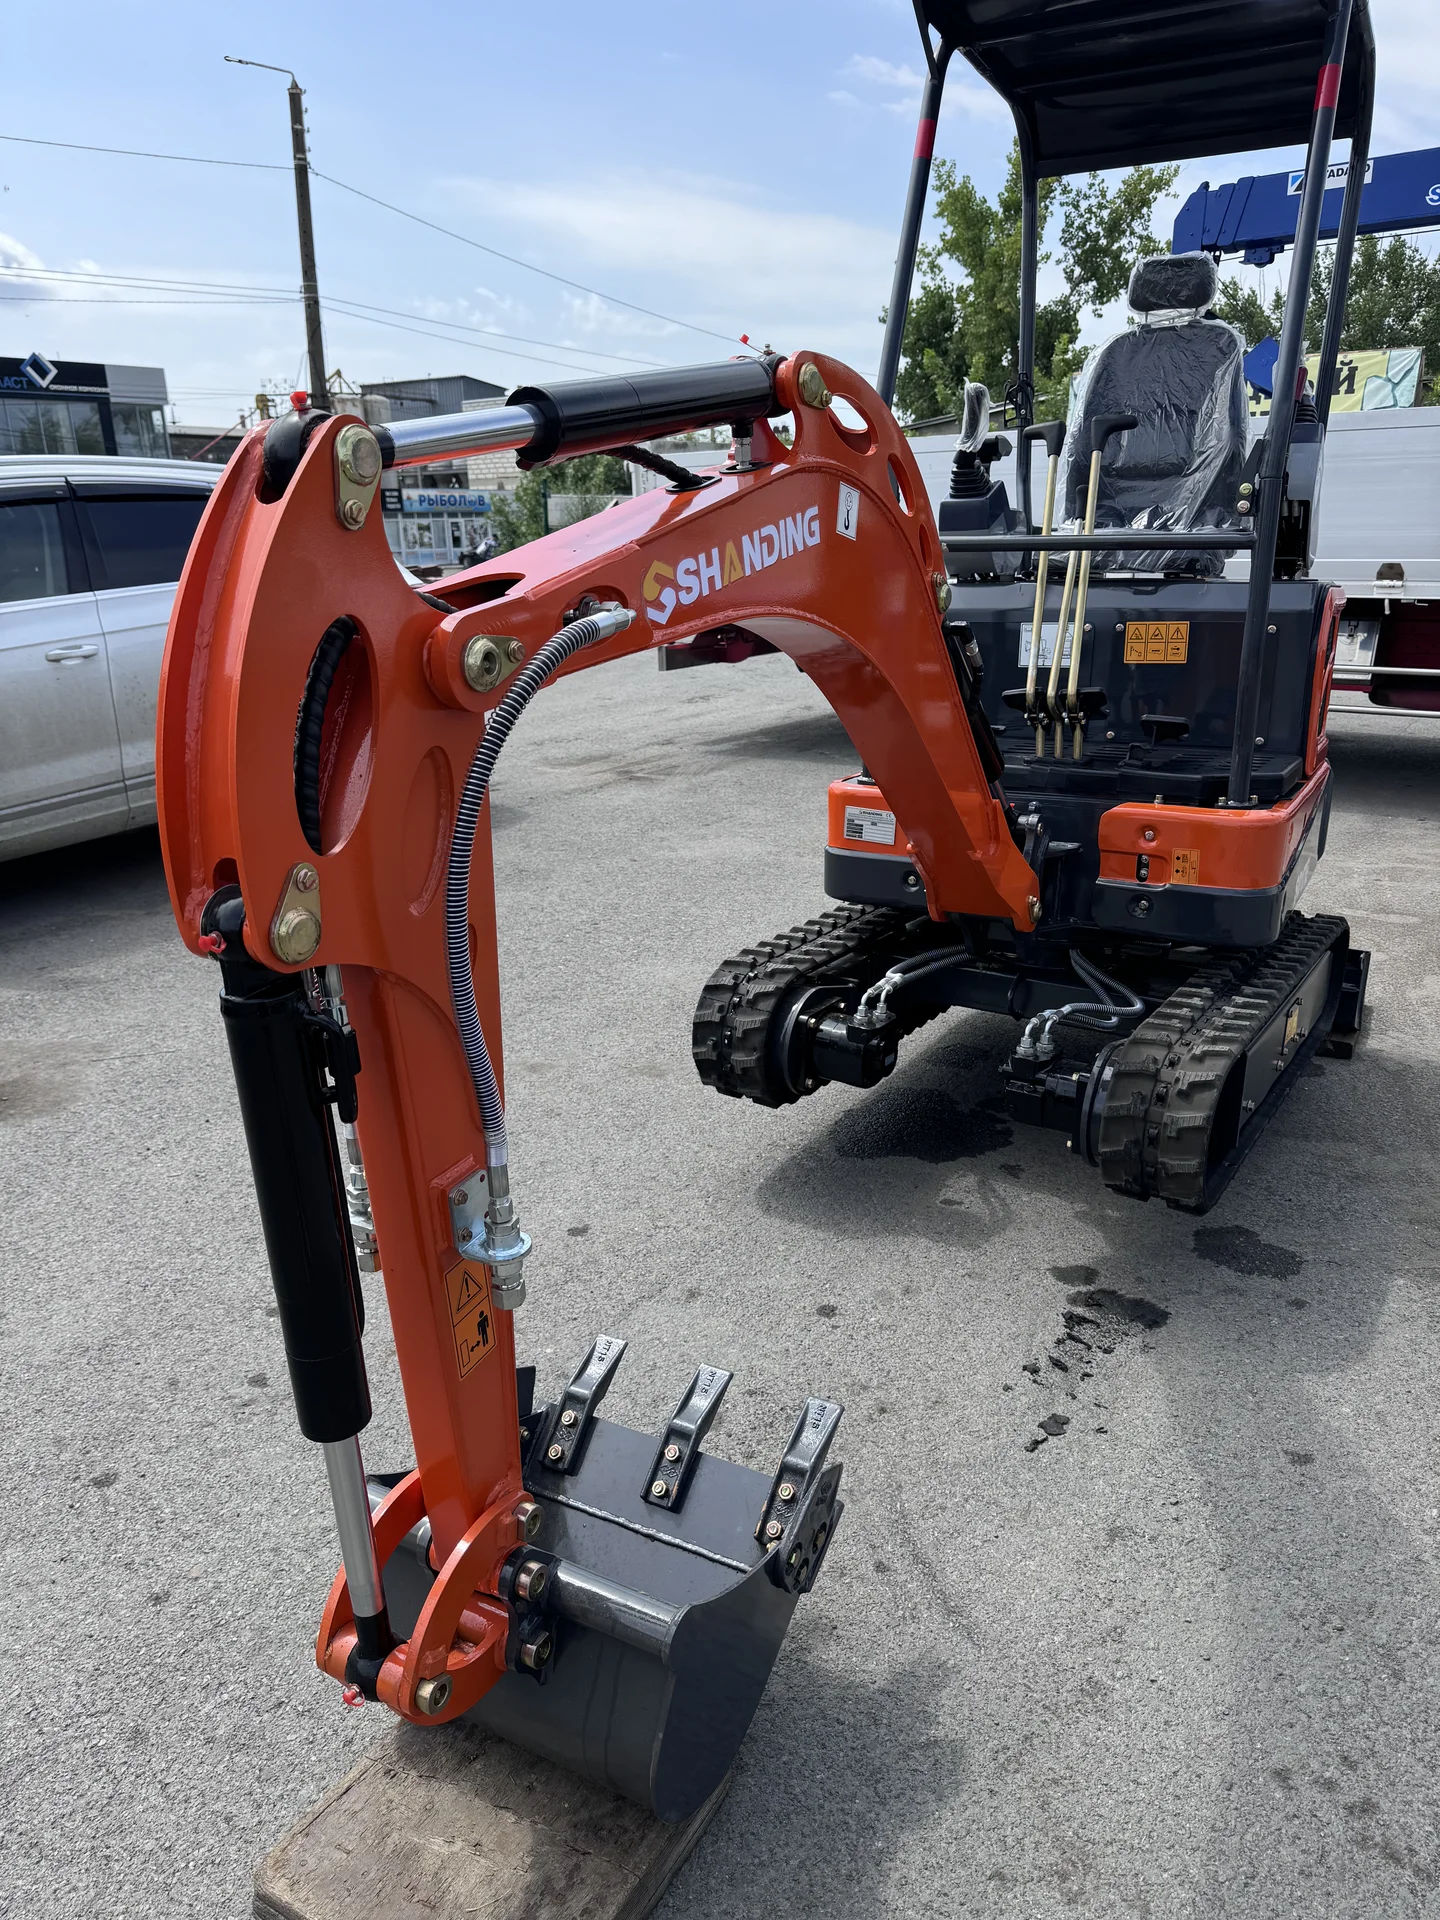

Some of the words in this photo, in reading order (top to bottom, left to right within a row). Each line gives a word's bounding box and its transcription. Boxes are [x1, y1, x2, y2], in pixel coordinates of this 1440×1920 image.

[418, 494, 486, 507] РЫБОЛОВ
[676, 505, 821, 606] SHANDING
[701, 1371, 717, 1394] NT15
[812, 1405, 828, 1429] NT15
